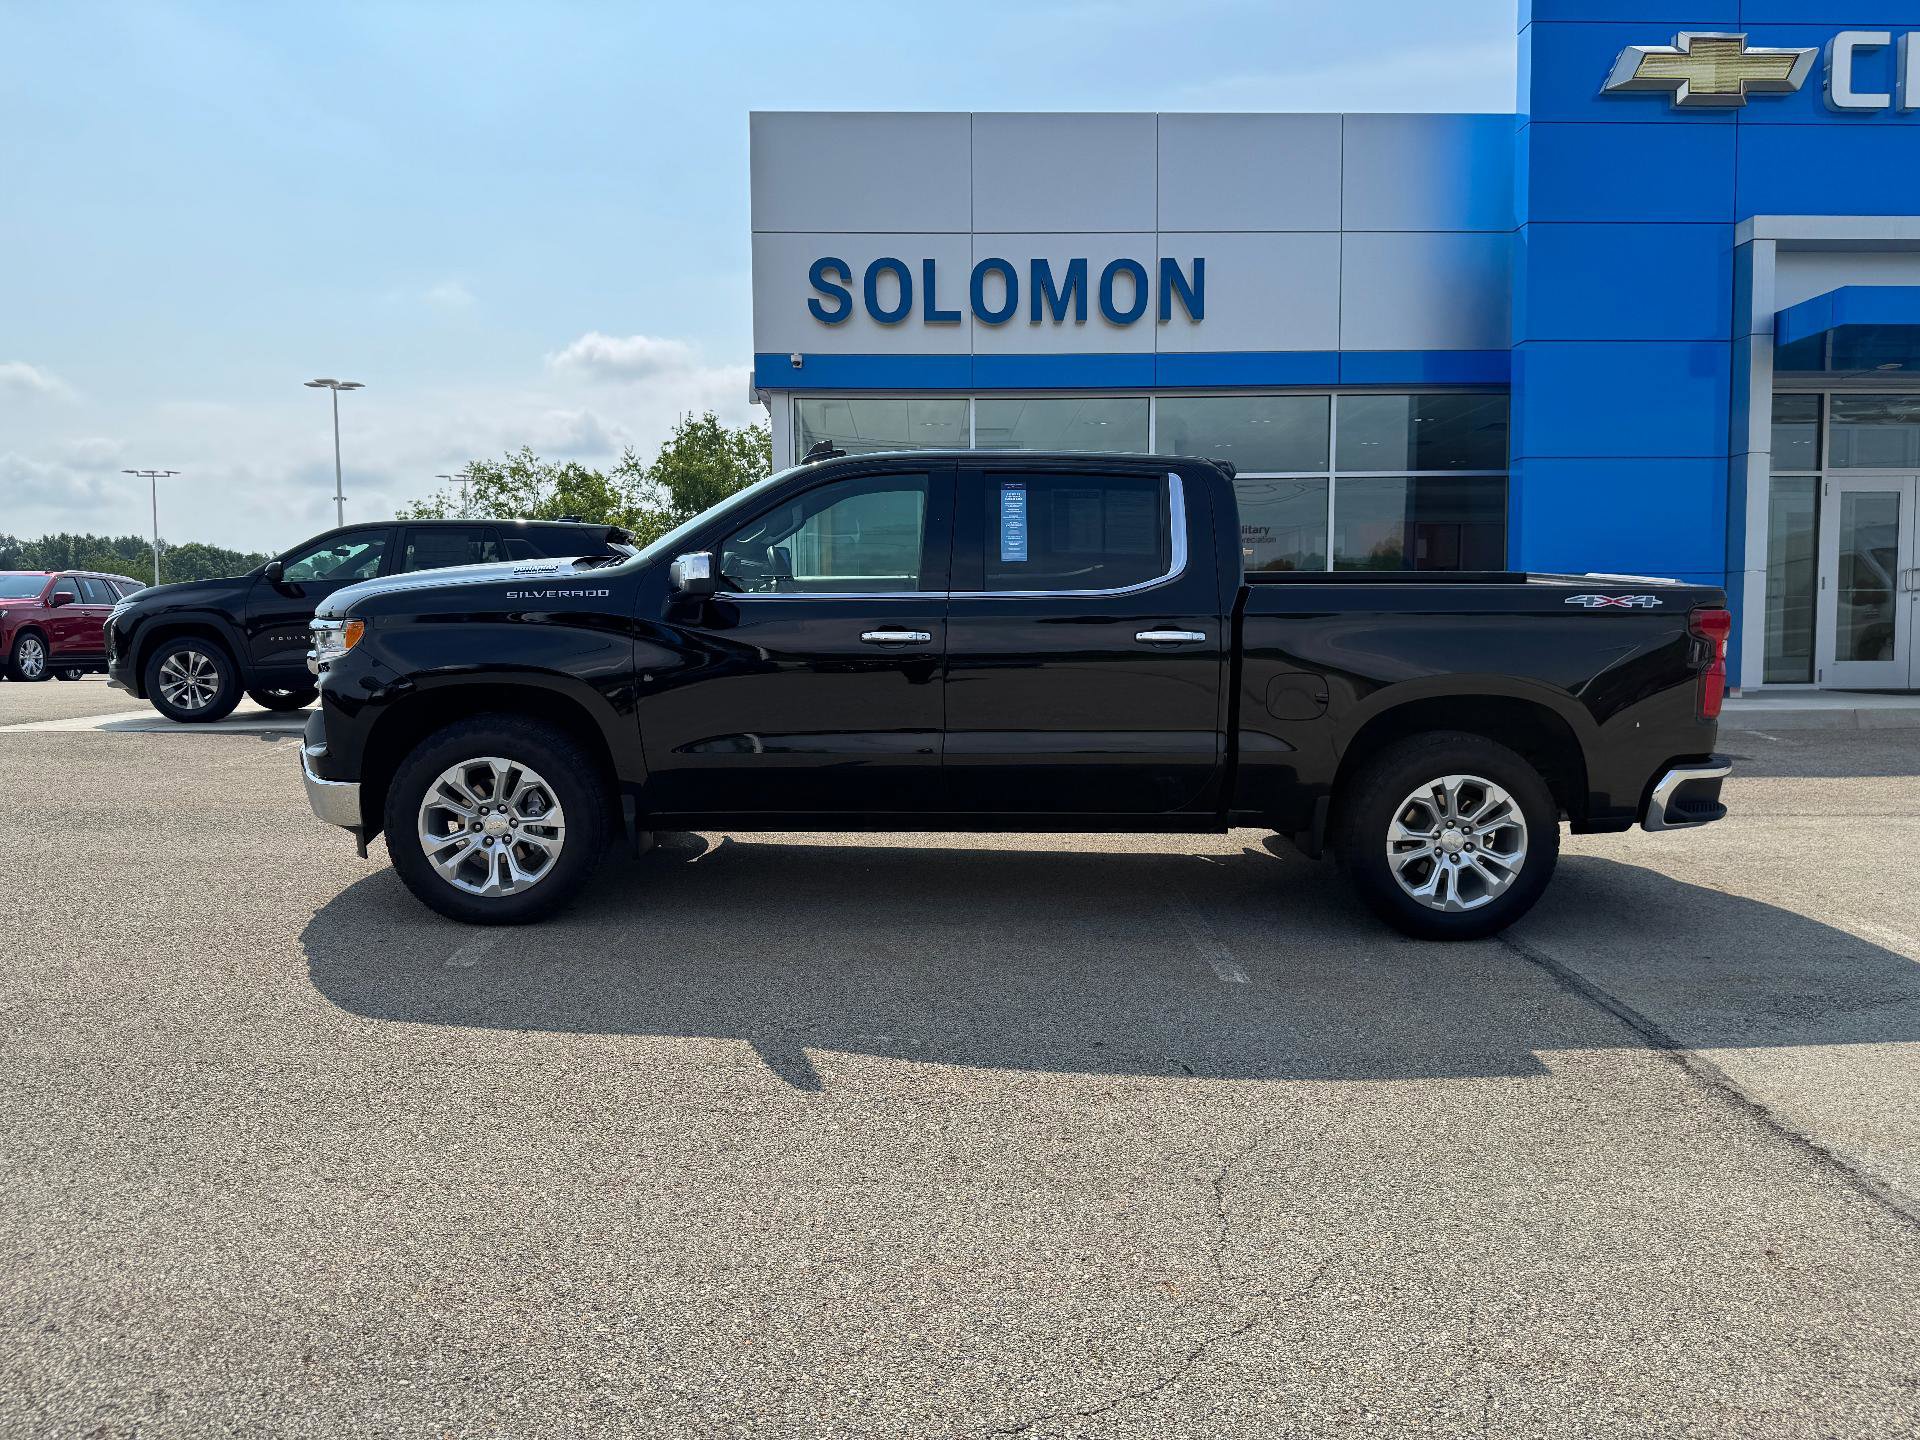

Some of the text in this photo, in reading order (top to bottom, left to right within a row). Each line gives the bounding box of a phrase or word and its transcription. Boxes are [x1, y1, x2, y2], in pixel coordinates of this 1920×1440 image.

[1824, 31, 1920, 111] C
[807, 256, 1205, 326] SOLOMON
[1241, 524, 1271, 536] litary
[1241, 535, 1277, 544] reciation
[506, 589, 610, 599] SILVERADO
